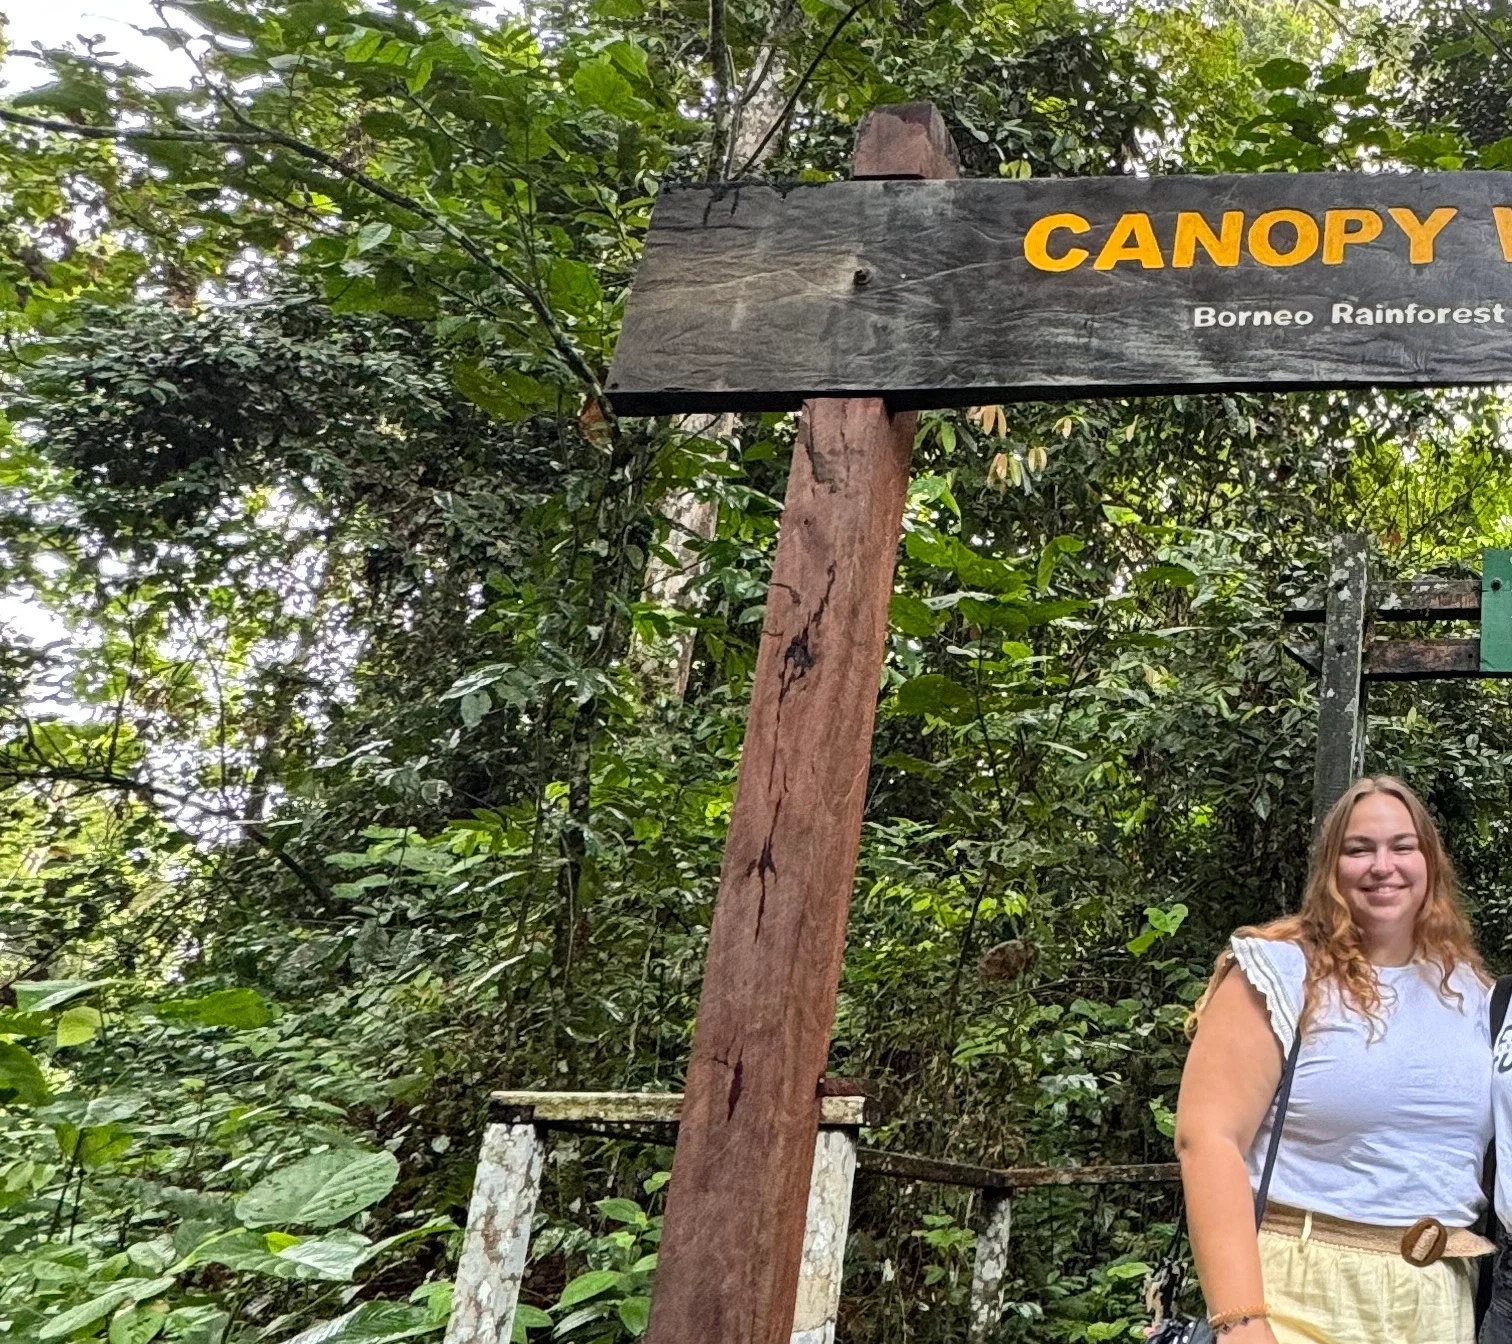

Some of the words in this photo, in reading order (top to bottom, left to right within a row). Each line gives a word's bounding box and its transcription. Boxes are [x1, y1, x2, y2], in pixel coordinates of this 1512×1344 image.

[1023, 206, 1458, 272] CANOPY
[1194, 306, 1314, 328] Borneo
[1331, 302, 1506, 326] Rainforest
